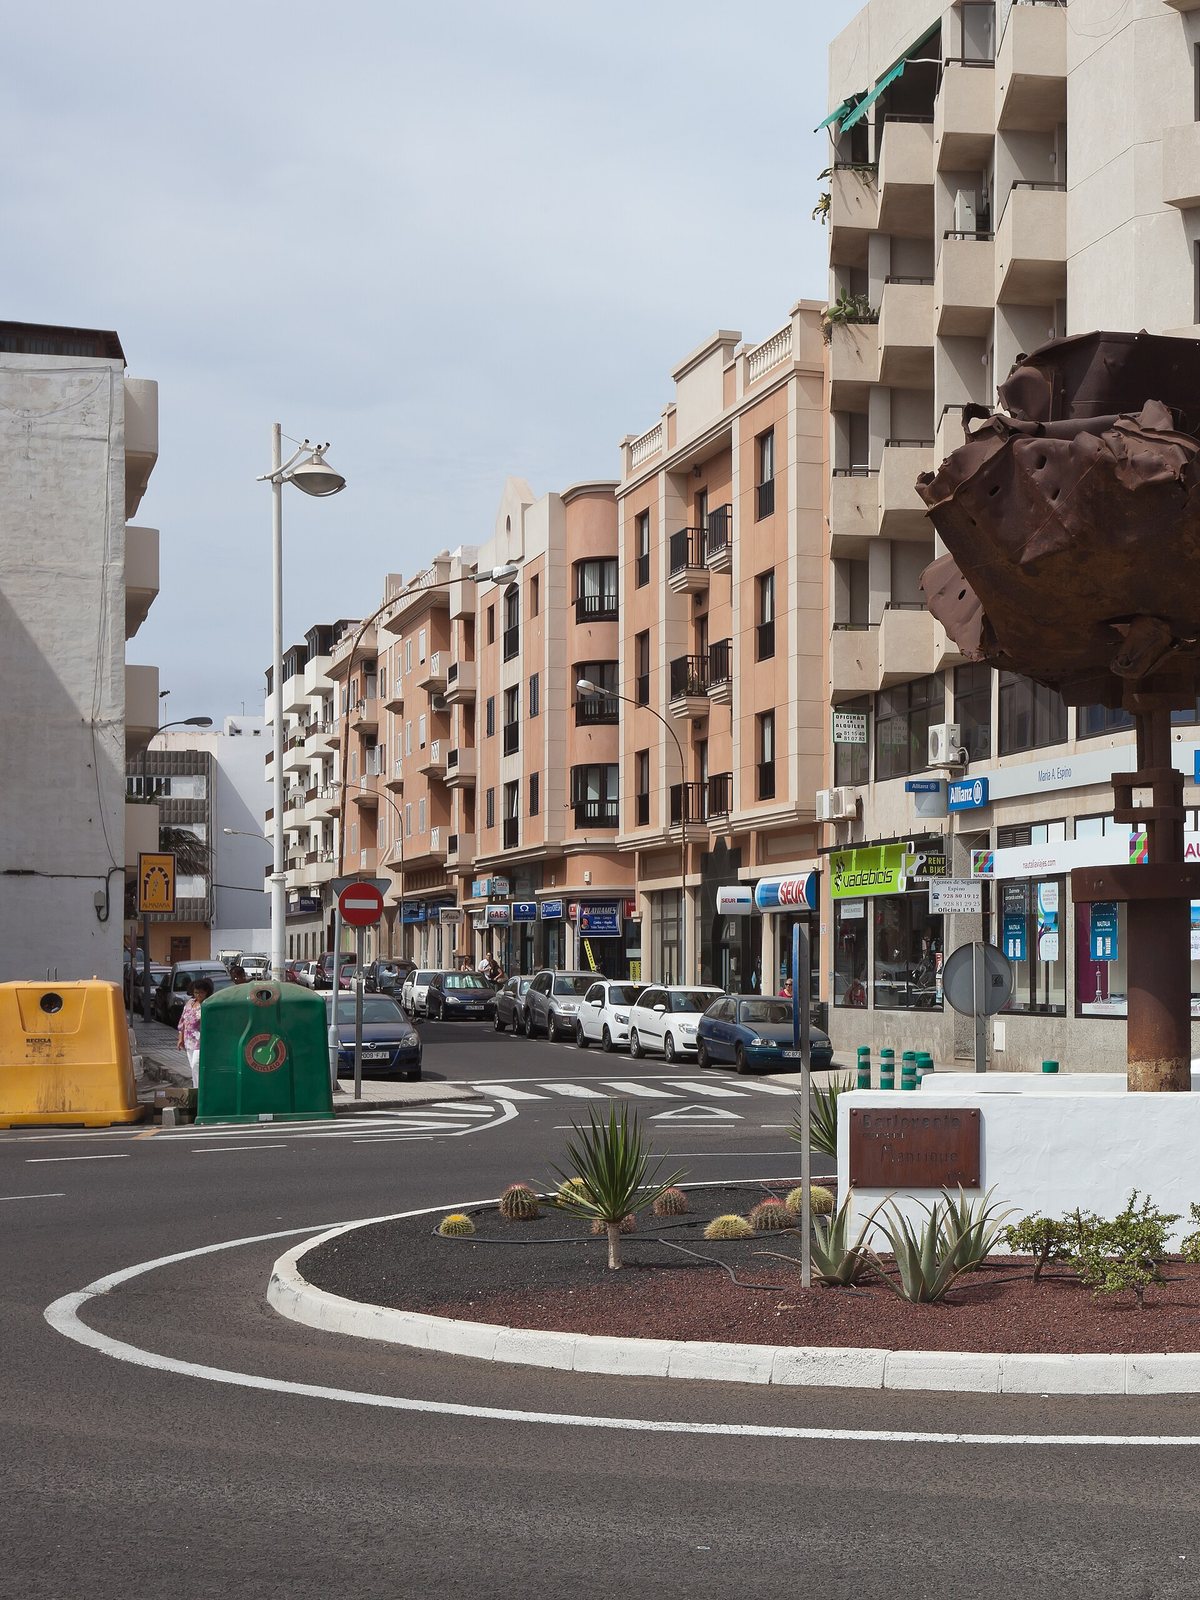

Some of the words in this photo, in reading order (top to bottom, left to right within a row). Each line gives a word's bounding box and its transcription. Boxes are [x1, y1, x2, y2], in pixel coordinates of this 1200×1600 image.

[1056, 767, 1072, 781] Espino
[950, 786, 972, 804] Allianz
[928, 856, 946, 865] RENT
[922, 866, 928, 874] A
[930, 866, 946, 874] BIKE
[780, 880, 806, 905] SEUR
[490, 910, 508, 918] GAES
